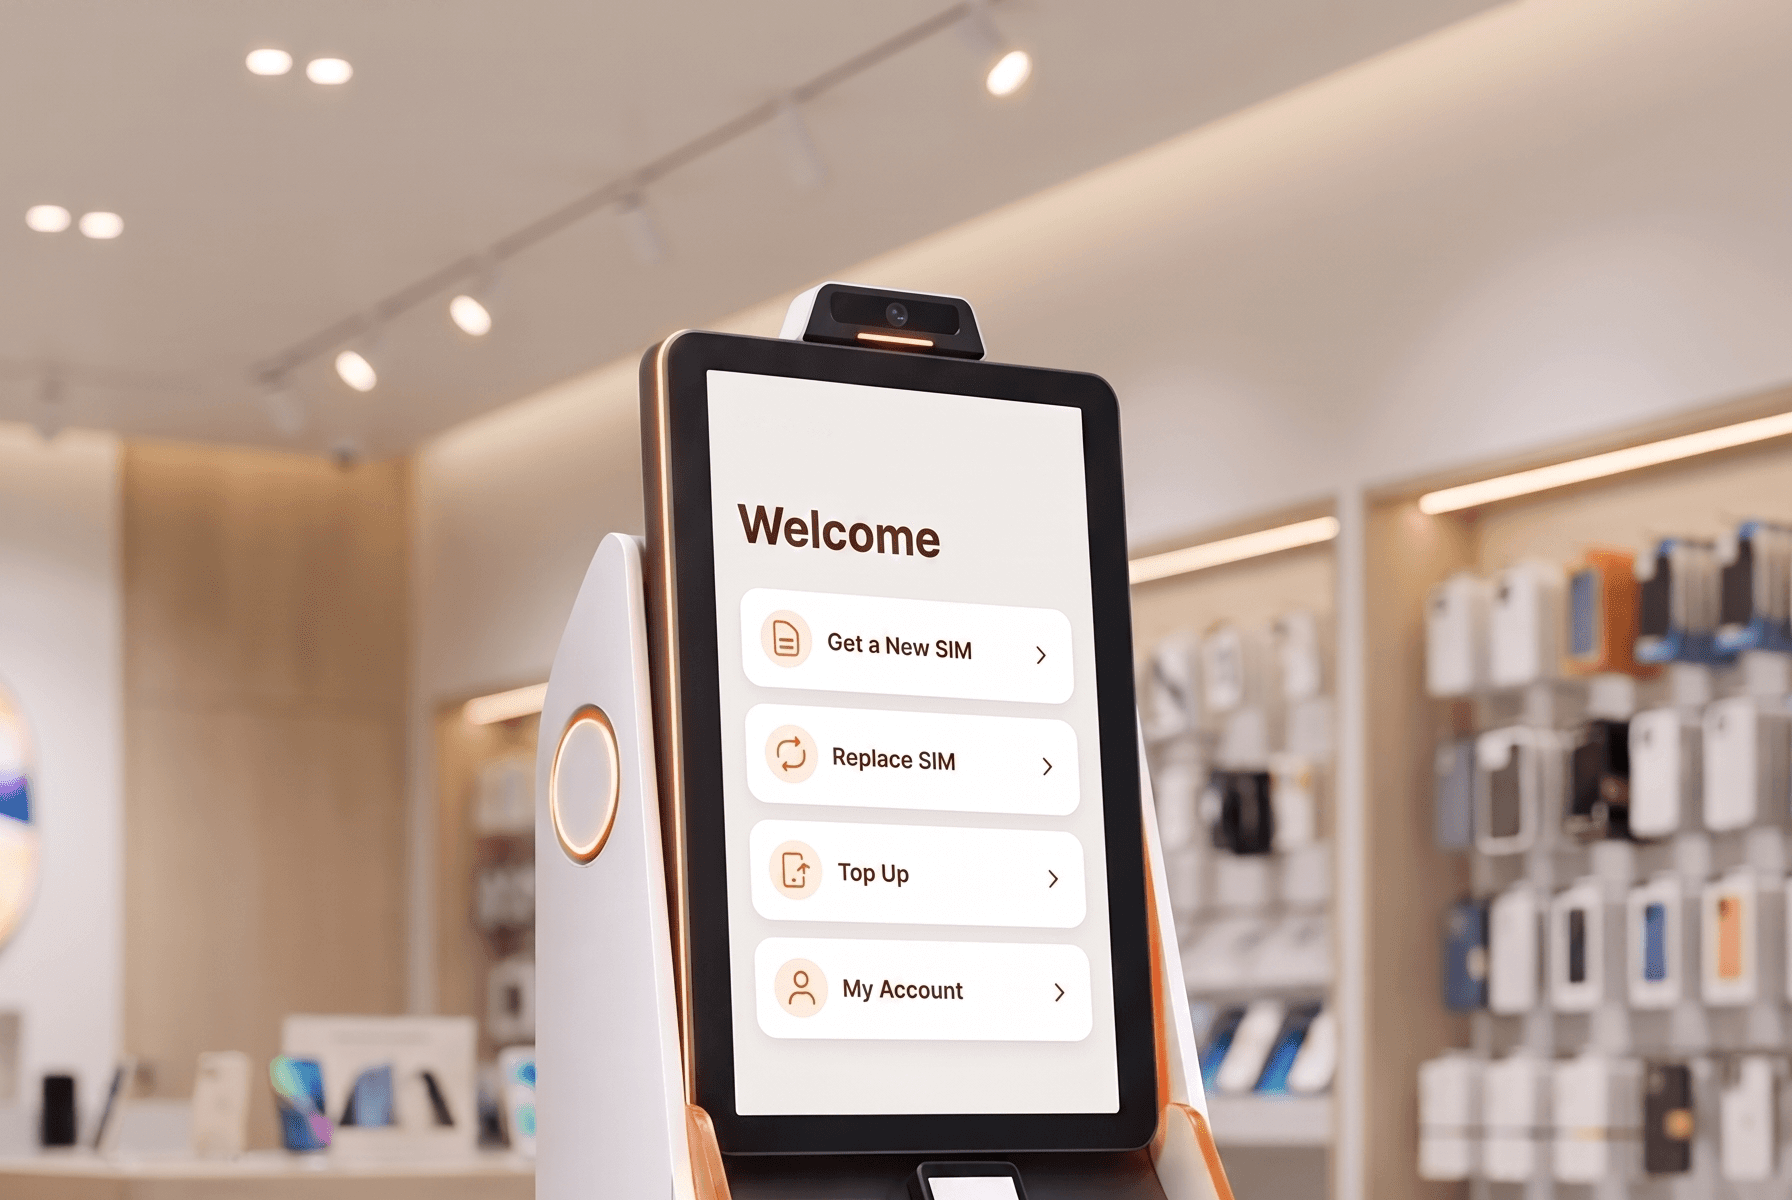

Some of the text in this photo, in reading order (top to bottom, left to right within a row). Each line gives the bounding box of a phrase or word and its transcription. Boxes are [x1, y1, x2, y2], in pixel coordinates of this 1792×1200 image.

[737, 503, 941, 559] Welcome
[827, 632, 973, 660] Get a New SIM
[832, 746, 956, 772] Replace SIM
[837, 862, 910, 888] Top Up
[842, 978, 964, 1003] My Account
